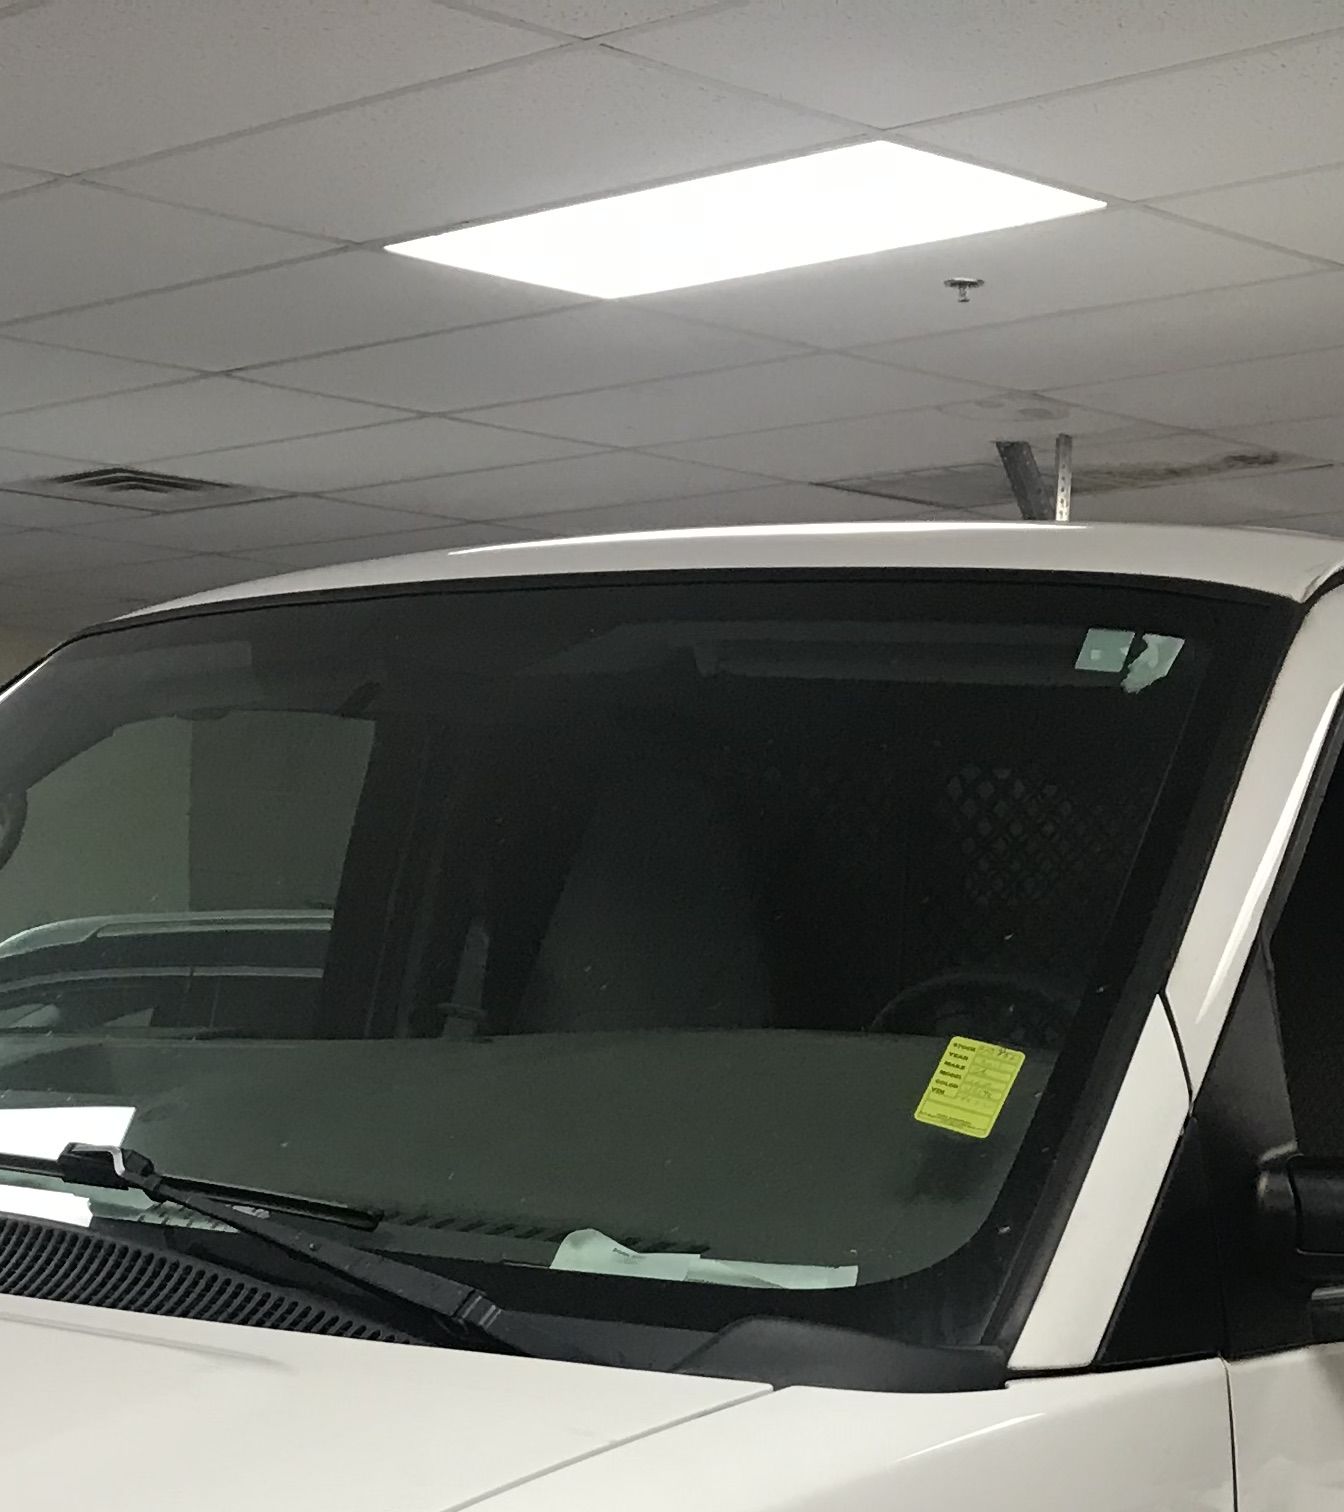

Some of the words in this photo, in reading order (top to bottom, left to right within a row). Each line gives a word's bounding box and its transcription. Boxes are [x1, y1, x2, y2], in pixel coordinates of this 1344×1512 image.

[948, 1052, 969, 1061] YEAR
[944, 1061, 966, 1070] MAKE
[939, 1070, 962, 1079] MODEL
[935, 1079, 959, 1088] COLOR
[931, 1086, 945, 1095] VIN
